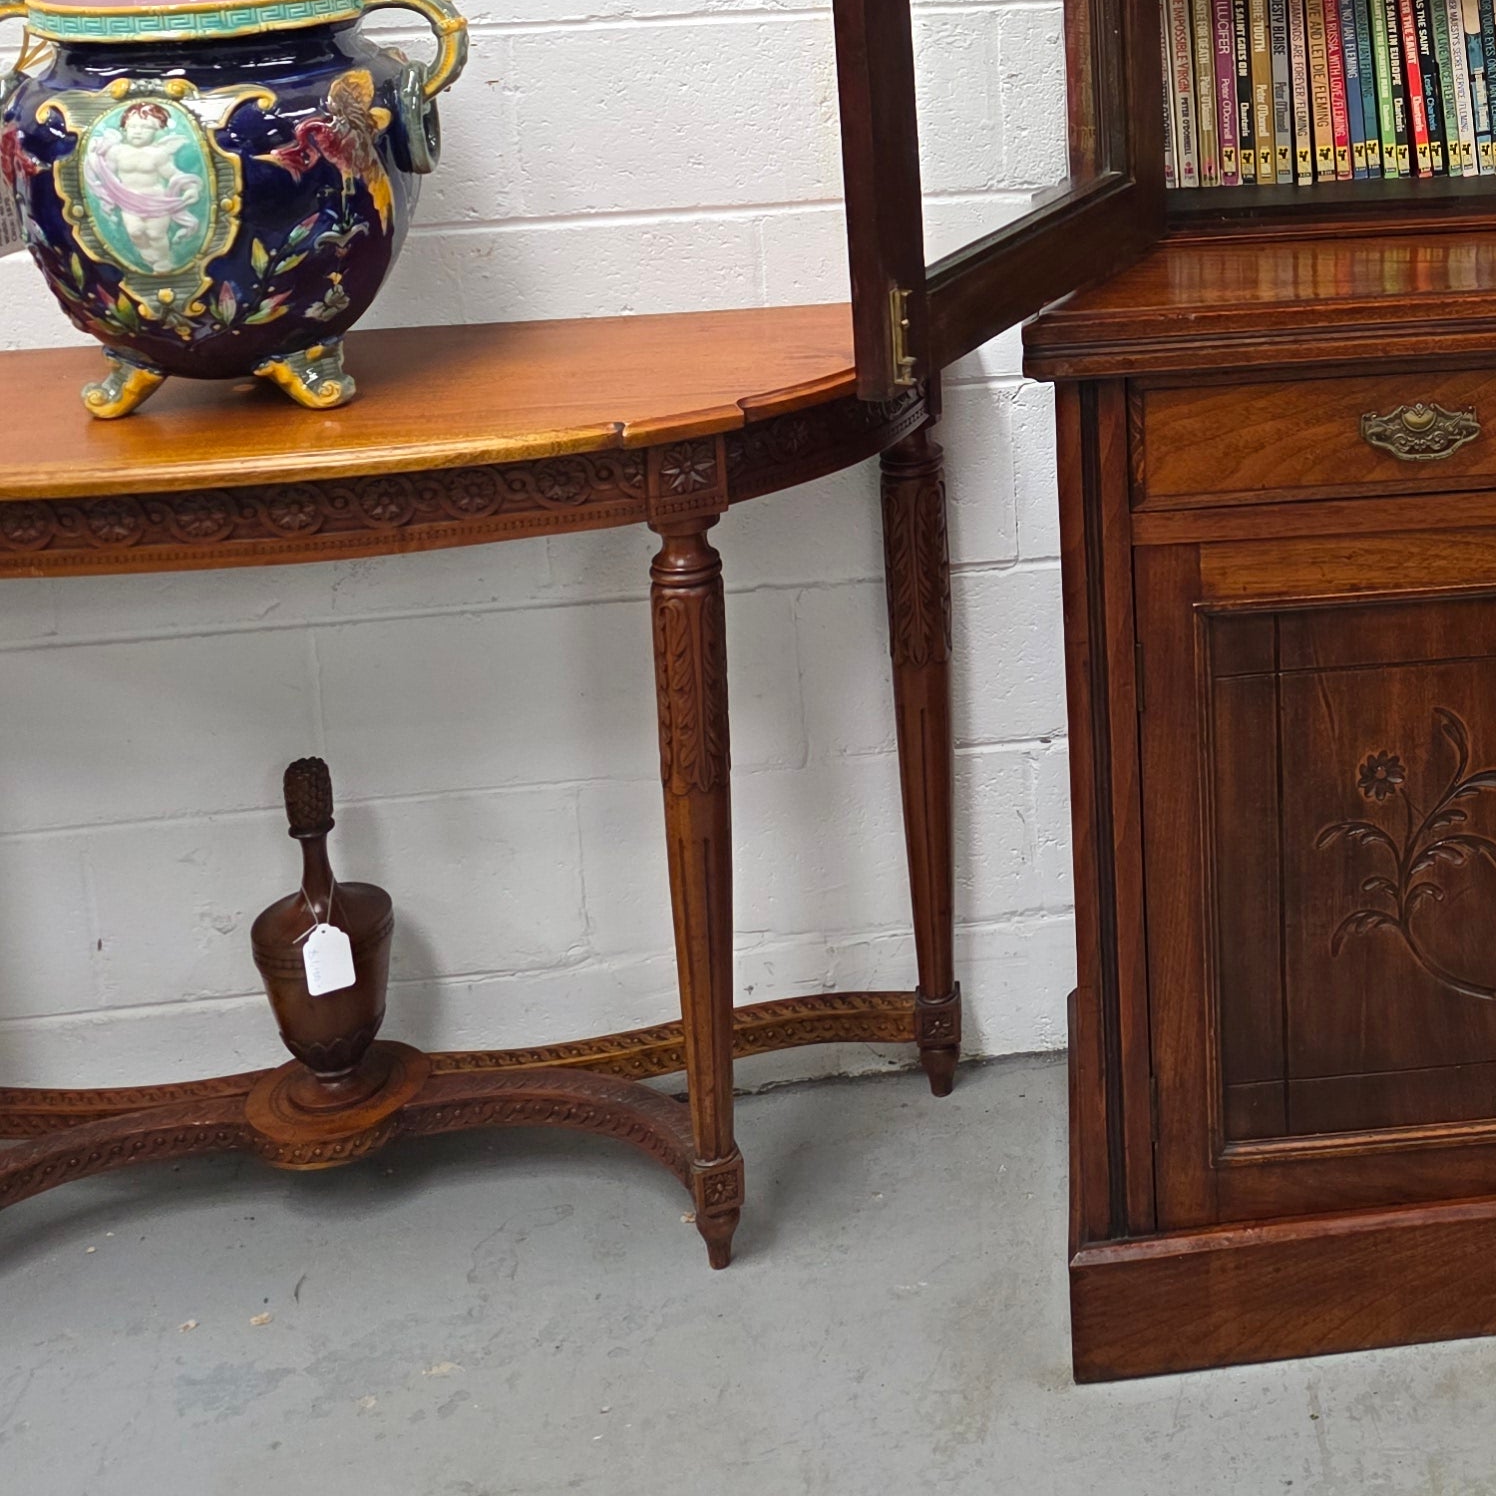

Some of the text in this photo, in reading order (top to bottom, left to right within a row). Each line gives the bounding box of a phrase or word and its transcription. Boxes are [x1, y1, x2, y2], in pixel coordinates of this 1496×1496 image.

[1217, 7, 1230, 54] LUCIFER
[1235, 8, 1245, 35] SAINT
[1386, 6, 1396, 33] SAINT
[1416, 10, 1427, 28] THE
[1173, 7, 1187, 60] IMPOSSIBLE
[1273, 26, 1285, 55] BLAISE
[1388, 35, 1398, 45] IN
[1418, 30, 1429, 55] SAINT
[1236, 38, 1246, 60] GOES
[1177, 63, 1189, 93] VIRGIN
[1238, 62, 1247, 76] ON
[1390, 47, 1401, 85] EUROPE
